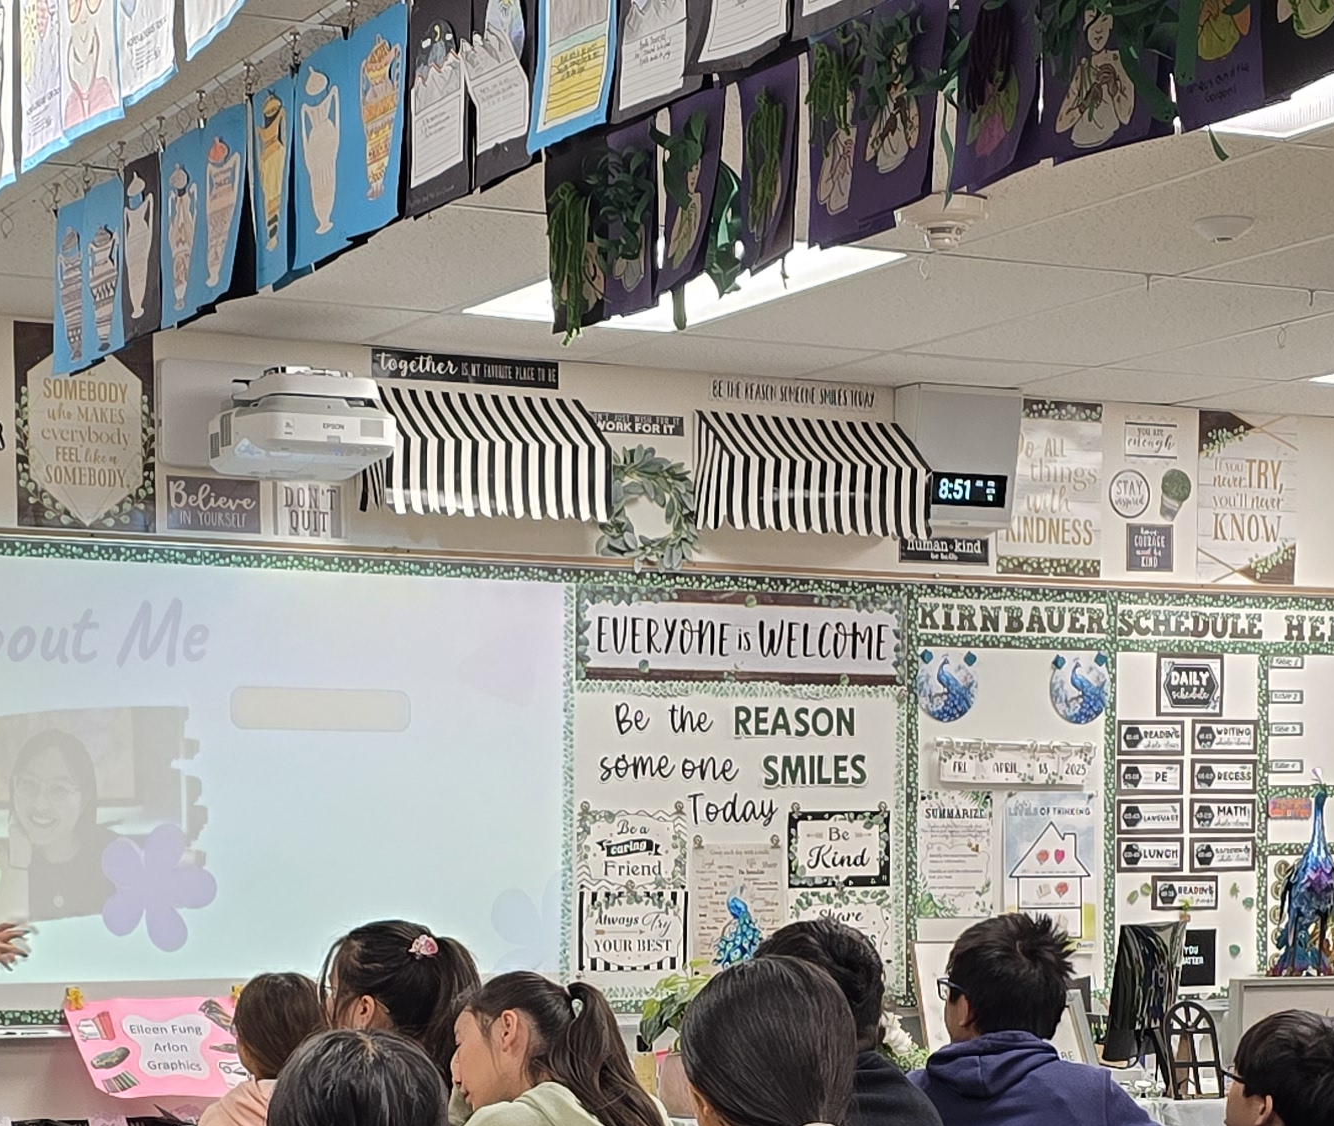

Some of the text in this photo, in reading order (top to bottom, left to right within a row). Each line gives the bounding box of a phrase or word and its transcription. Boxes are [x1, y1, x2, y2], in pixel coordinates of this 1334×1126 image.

[376, 351, 535, 381] together FAVORITE PLACE
[43, 378, 128, 404] SOMEBODY
[744, 383, 875, 408] REASON SOMEONE SMILES TODAY
[47, 403, 125, 425] who MAKES
[322, 421, 345, 431] EPSON
[597, 420, 674, 434] WORK FOR IT
[41, 426, 131, 447] everybody
[1127, 433, 1175, 453] enough
[55, 446, 80, 463] FEEL
[1044, 438, 1067, 458] ALL
[1030, 457, 1098, 492] things
[1212, 473, 1246, 488] never
[169, 480, 256, 511] Believe
[938, 478, 971, 500] 8:51
[1116, 480, 1143, 495] STAY
[283, 485, 336, 512] DON'T
[1026, 485, 1071, 514] with
[1212, 493, 1284, 510] you'll never
[179, 511, 247, 528] IN YOURSELF
[289, 509, 329, 532] QUIT
[1212, 512, 1282, 543] KNOW
[1005, 516, 1093, 546] KINDNESS
[919, 602, 1107, 635] KIRNBAUER
[1117, 608, 1263, 640] SCHEDULE
[117, 597, 210, 669] Me
[597, 616, 890, 661] EVERYONE is WELCOME
[1170, 671, 1210, 686] DAILY
[615, 702, 856, 738] Be the REASON
[1143, 730, 1181, 739] READING
[762, 754, 868, 787] SMILES
[992, 762, 1087, 776] APRIL 2025
[1154, 771, 1252, 782] PE RECESS
[687, 792, 779, 827] Today
[924, 807, 985, 819] SUMMARIZE
[1053, 807, 1091, 816] THINKING
[1217, 805, 1247, 817] MATH
[617, 819, 637, 835] Be
[829, 827, 850, 841] Be
[610, 840, 647, 855] caring
[1143, 848, 1179, 860] LUNCH
[806, 844, 871, 870] Kind
[603, 860, 662, 877] Friend
[595, 914, 640, 927] Always
[593, 939, 673, 953] YOUR BEST
[129, 1024, 203, 1036] Eileen Fung
[153, 1042, 188, 1053] Arlon
[147, 1060, 203, 1072] Graphics
